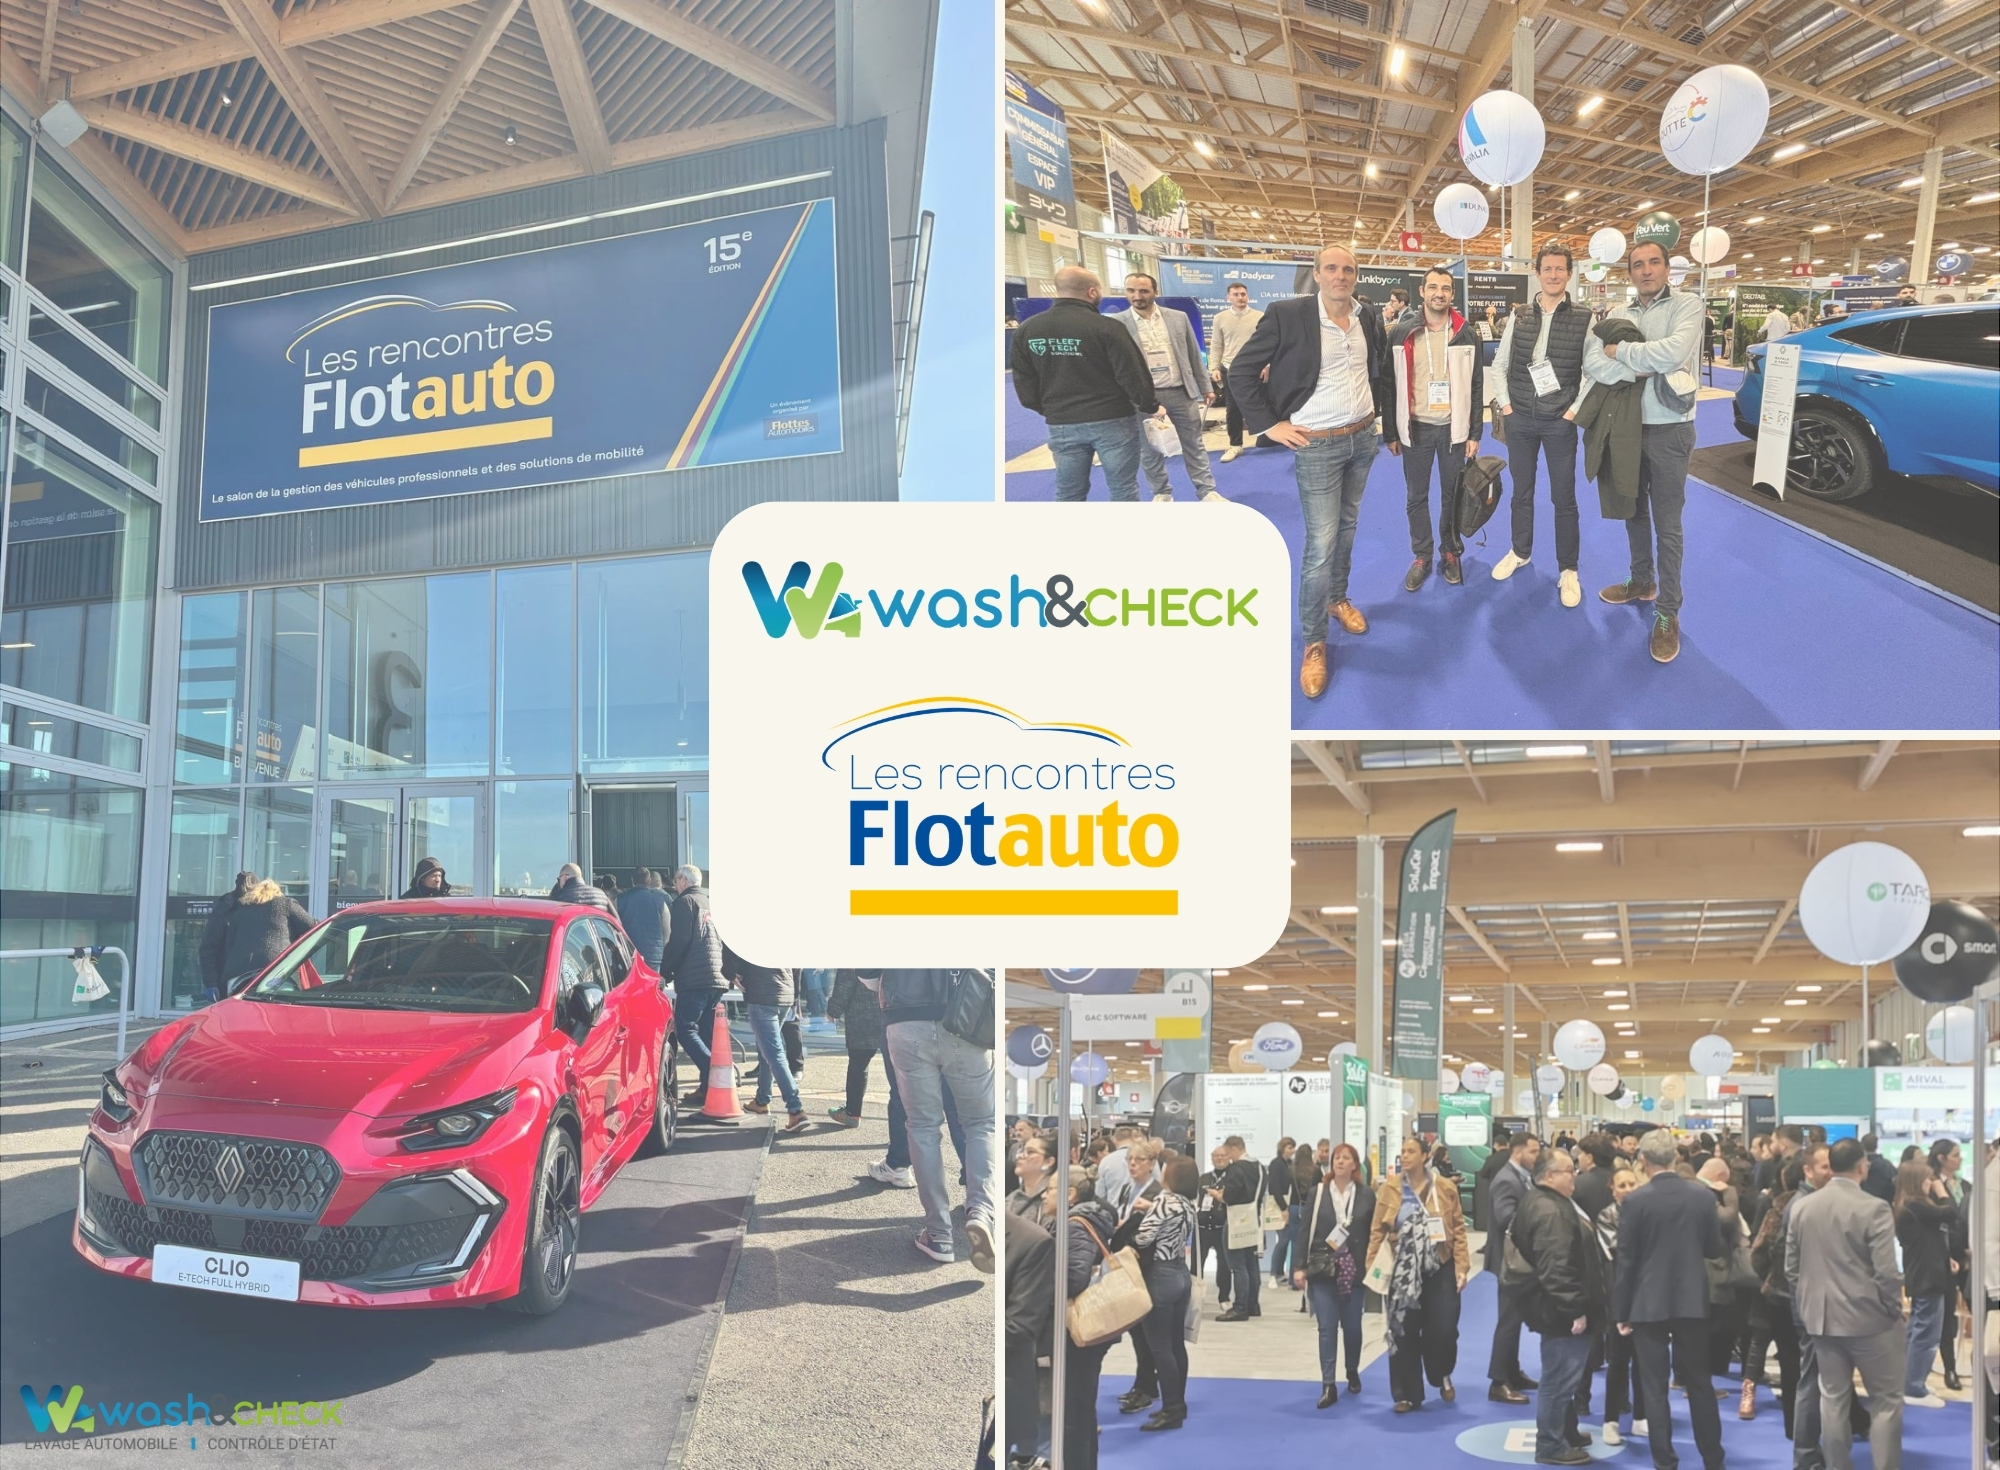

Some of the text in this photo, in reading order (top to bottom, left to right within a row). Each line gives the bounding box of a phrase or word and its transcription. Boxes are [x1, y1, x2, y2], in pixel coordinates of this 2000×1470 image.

[1007, 106, 1065, 148] COMMISSARIAT
[1021, 129, 1059, 158] GÉNÉRAL
[1027, 152, 1058, 175] ESPACE
[1034, 170, 1055, 191] VIP
[1650, 222, 1670, 233] Vert
[709, 262, 741, 274] ÉDITION
[1241, 271, 1275, 281] Dadycar
[304, 320, 553, 377] Les rencontres
[302, 354, 555, 434] Flotauto
[772, 419, 810, 430] Flottes
[212, 445, 644, 504] Le salon de la gestion des véhicules professionnels et des solutions de mobilité
[1085, 1013, 1147, 1022] GAC SOFTWARE
[1263, 1039, 1290, 1051] Ford
[1907, 1075, 1945, 1084] ARVAL
[204, 1257, 250, 1278] CLIO
[178, 1272, 270, 1293] E-TECH FULL HYBRID
